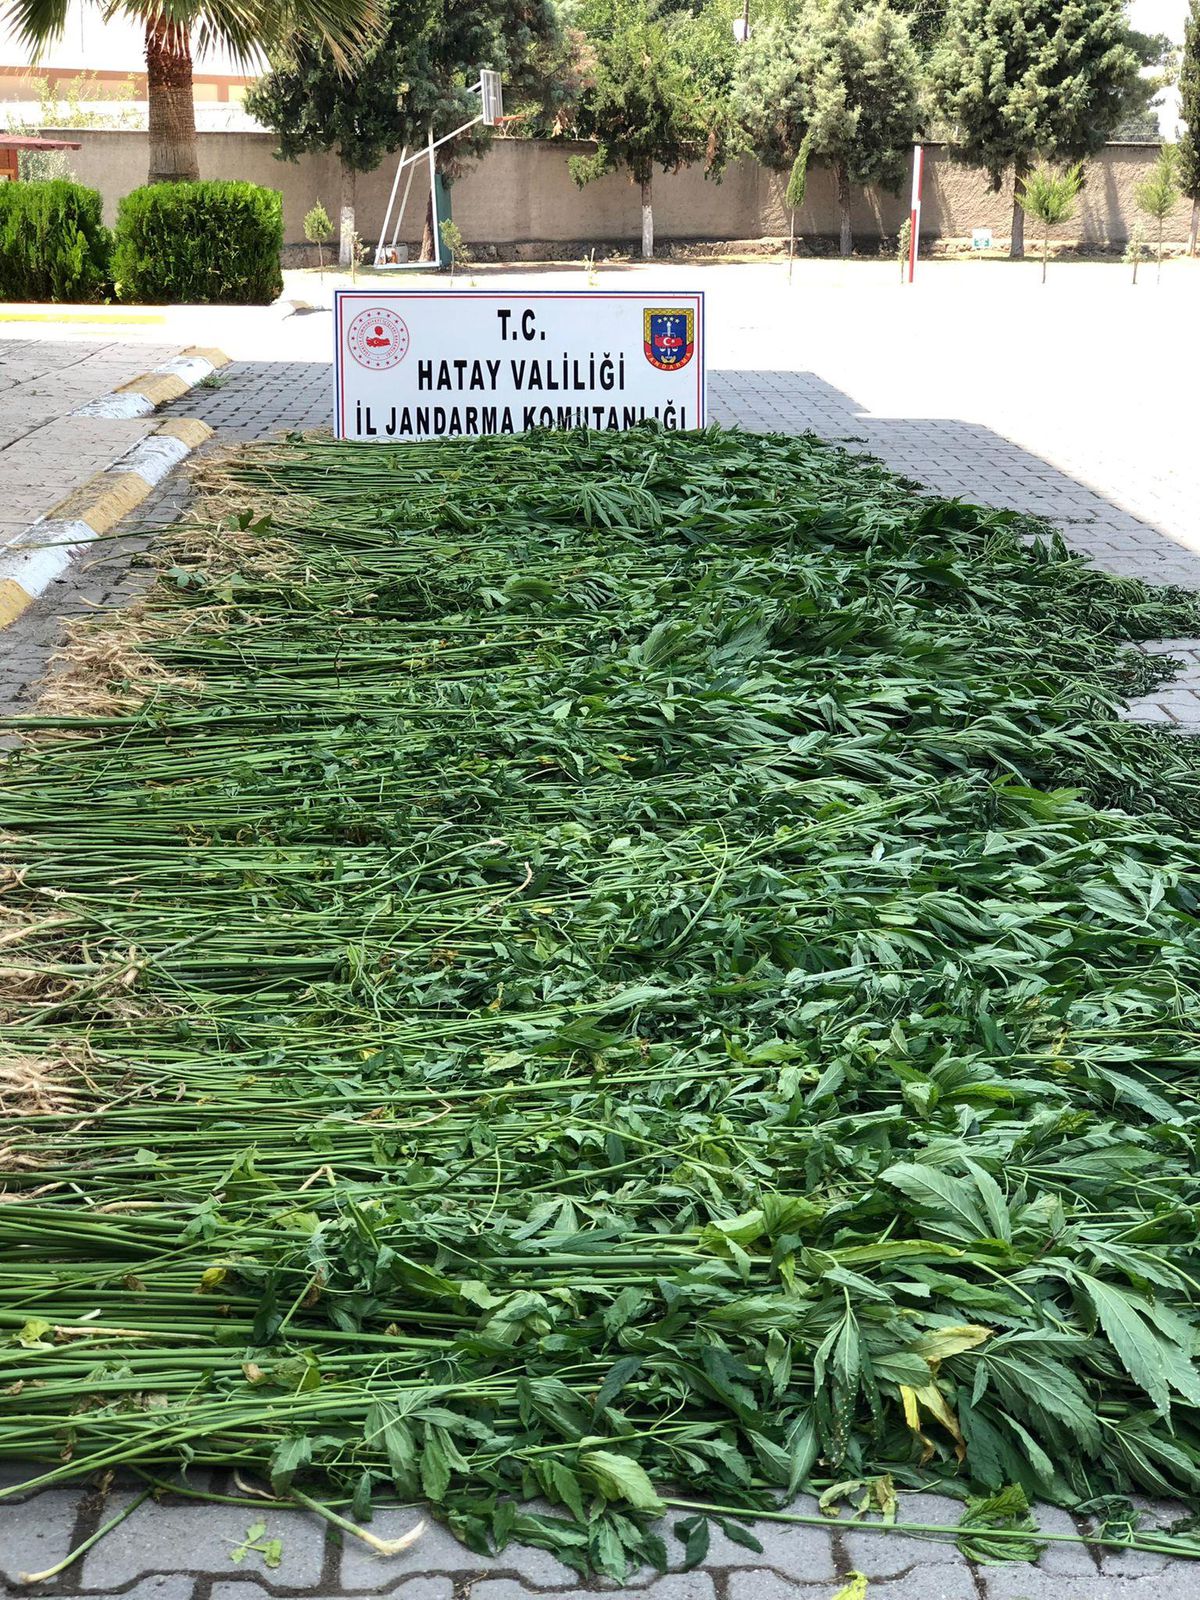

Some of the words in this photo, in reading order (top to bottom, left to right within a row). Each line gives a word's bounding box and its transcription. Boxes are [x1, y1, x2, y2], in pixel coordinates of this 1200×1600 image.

[498, 309, 546, 341] T.C.
[418, 359, 500, 390] HATAY
[510, 351, 624, 390] VALİLİĞİ
[356, 399, 377, 436] İL
[386, 405, 514, 435] JANDARMA
